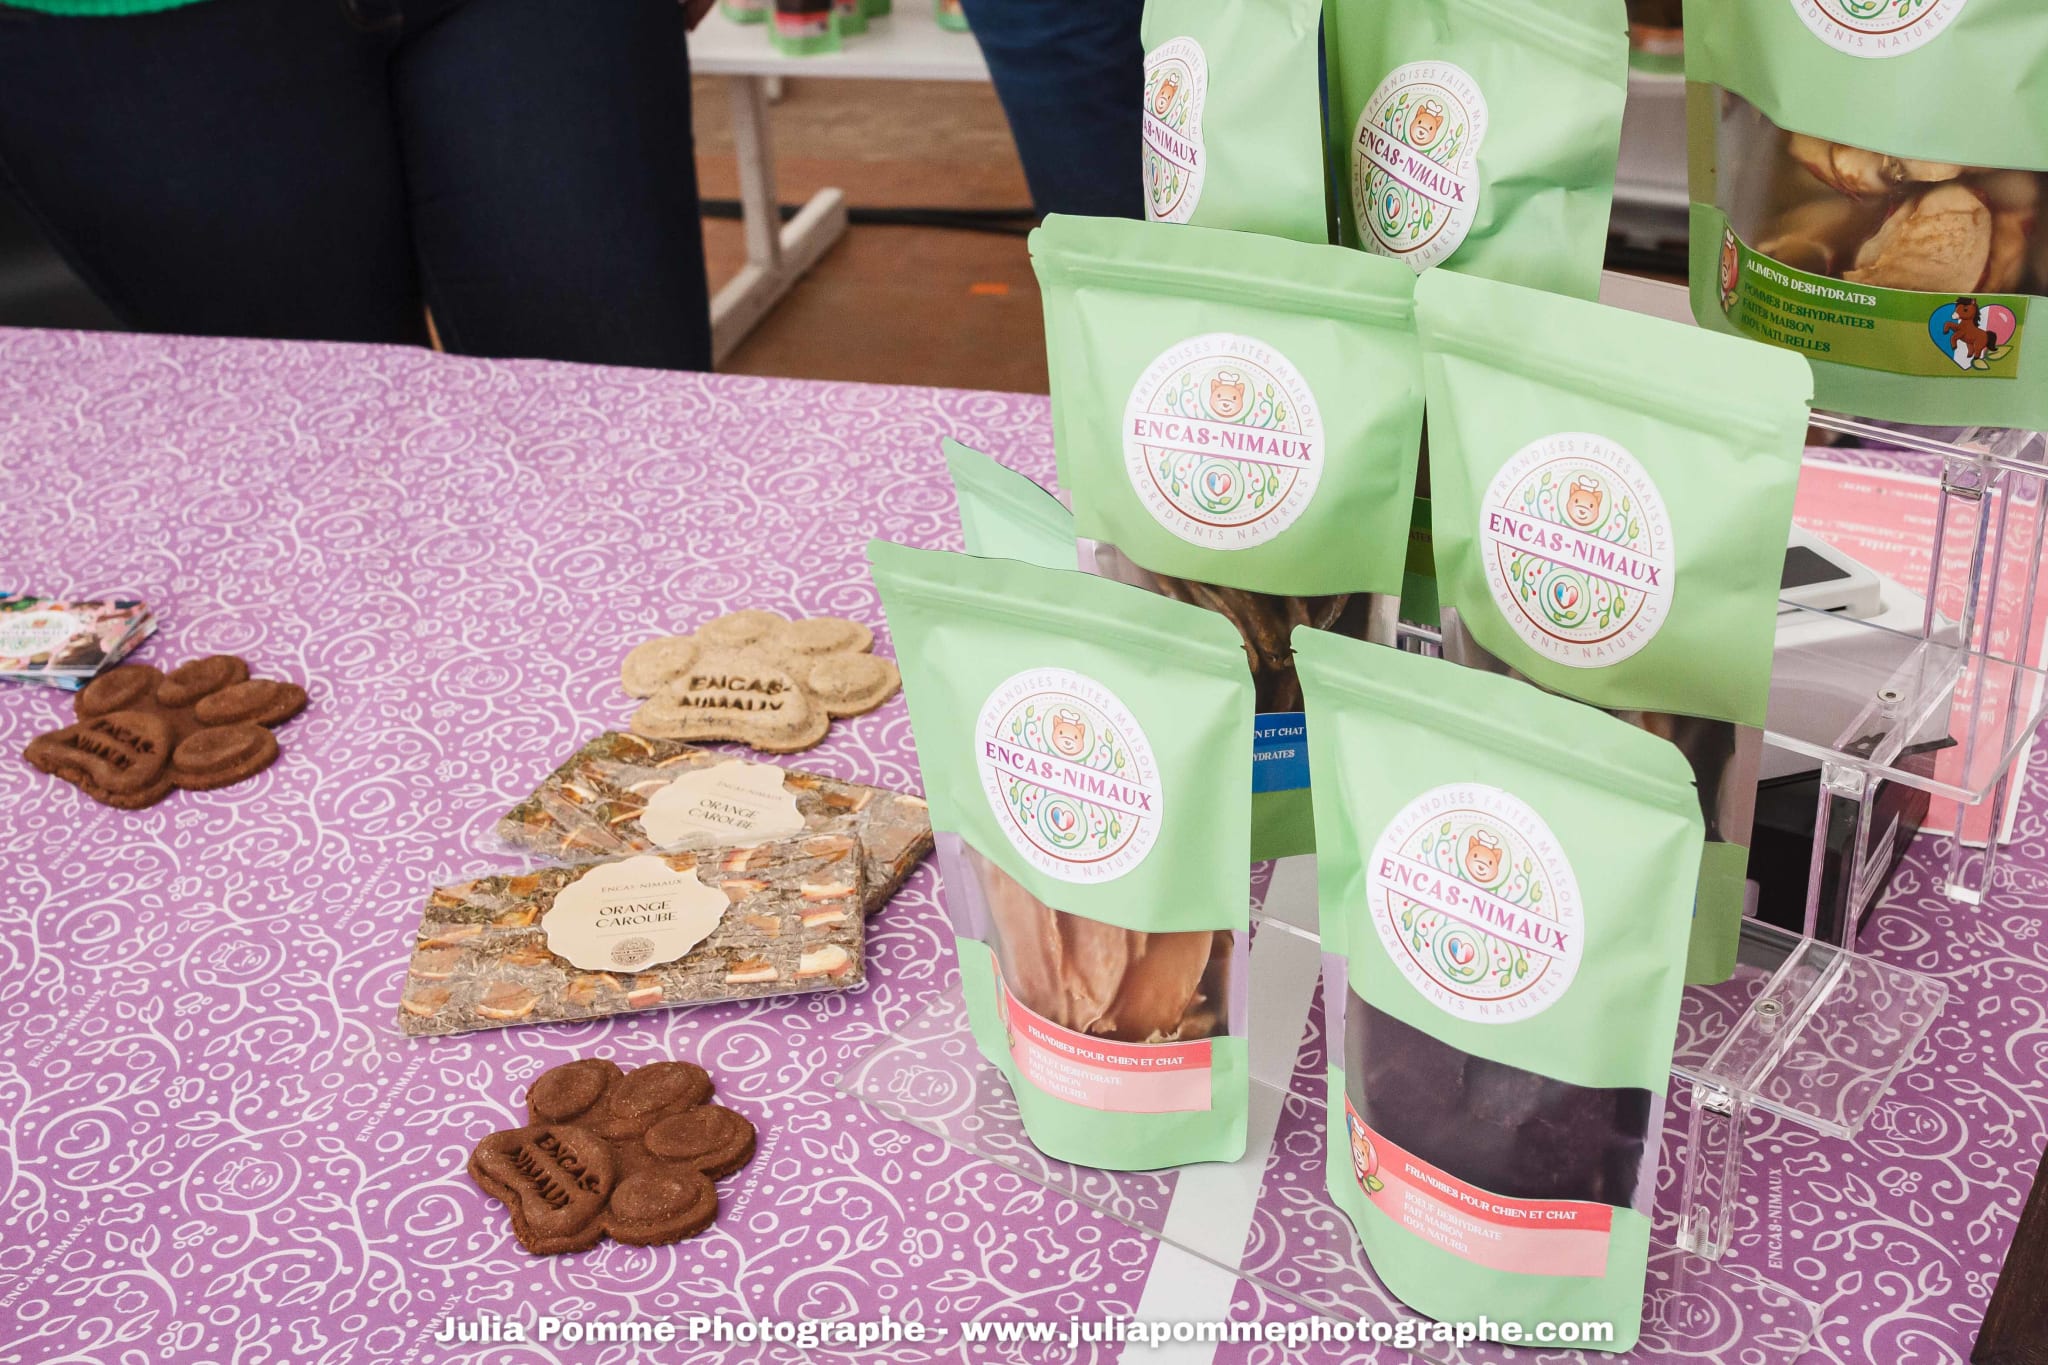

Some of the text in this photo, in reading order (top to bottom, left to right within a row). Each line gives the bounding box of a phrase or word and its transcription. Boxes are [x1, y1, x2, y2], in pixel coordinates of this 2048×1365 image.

[1440, 70, 1474, 104] FAITES
[1358, 126, 1466, 202] ENCAS-NIMAUX
[1742, 297, 1814, 334] FAITES MAISON
[1743, 283, 1875, 330] POMMES DESHYDRATEES
[1747, 259, 1877, 306] ALIMENTS DESHYDRATES
[1761, 324, 1831, 353] NATURELLES
[1136, 340, 1315, 428] FRIANDISES FAITES MAISON
[1134, 418, 1312, 461] ENCAS-NIMAUX
[1131, 456, 1309, 540] INGREDIENTS NATURELS
[1493, 440, 1665, 551] FRIANDISES FAITES MAISON
[1489, 512, 1661, 587] ENCAS-NIMAUX
[1487, 552, 1657, 658] INGREDIENTS NATURELS
[985, 676, 1153, 779] FRIANDISES FAITES MAISON
[1264, 728, 1277, 738] ET
[1278, 726, 1304, 737] CHAT
[699, 799, 758, 819] ORANGE
[985, 741, 1152, 812] ENCAS-NIMAUX
[688, 807, 754, 830] CAROUBE
[986, 776, 1151, 877] INGREDIENTS NATURELS
[1388, 792, 1574, 918] FRIANDISES FAITES MAISON
[595, 911, 679, 928] CAROUBE
[599, 900, 673, 916] ORANGE
[1378, 857, 1569, 953] ENCAS-NIMAUX
[1373, 899, 1563, 1015] INGREDIENTS NATURELS
[1028, 1024, 1185, 1067] FRIANDISES POUR CHIEN ET CHAT
[727, 1124, 784, 1222] ENCAS-NIMAUX
[1405, 1163, 1578, 1220] FRIANDISES POUR CHIEN ET CHAT
[1767, 1167, 1783, 1270] ENCAS-NIMAUX
